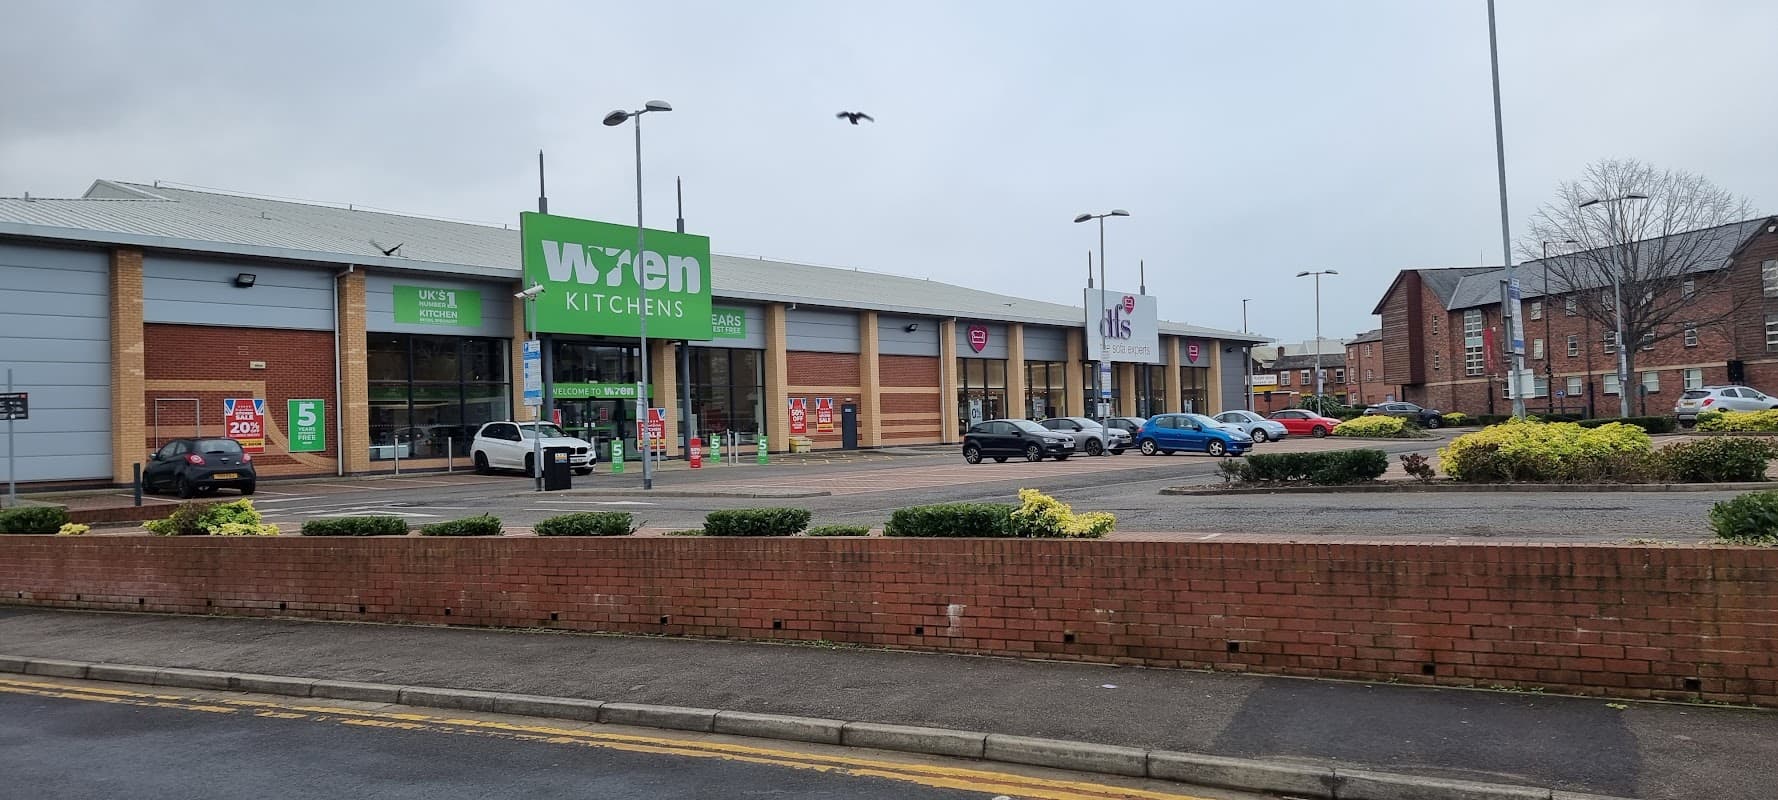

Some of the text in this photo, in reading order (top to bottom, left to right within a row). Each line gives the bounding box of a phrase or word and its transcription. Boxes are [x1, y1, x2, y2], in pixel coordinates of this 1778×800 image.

[541, 240, 700, 294] wren
[418, 290, 446, 301] UK'S
[418, 300, 446, 308] NUMBER
[566, 291, 683, 318] KITCHENS
[420, 309, 458, 319] KITCHEN
[711, 314, 741, 327] EARS
[1100, 303, 1131, 340] dfs
[1112, 343, 1127, 354] sofa
[1127, 345, 1151, 357] experts
[591, 387, 601, 395] TO
[297, 403, 317, 427] 5
[613, 443, 622, 457] 5
[711, 438, 719, 449] 5
[759, 439, 767, 450] 5
